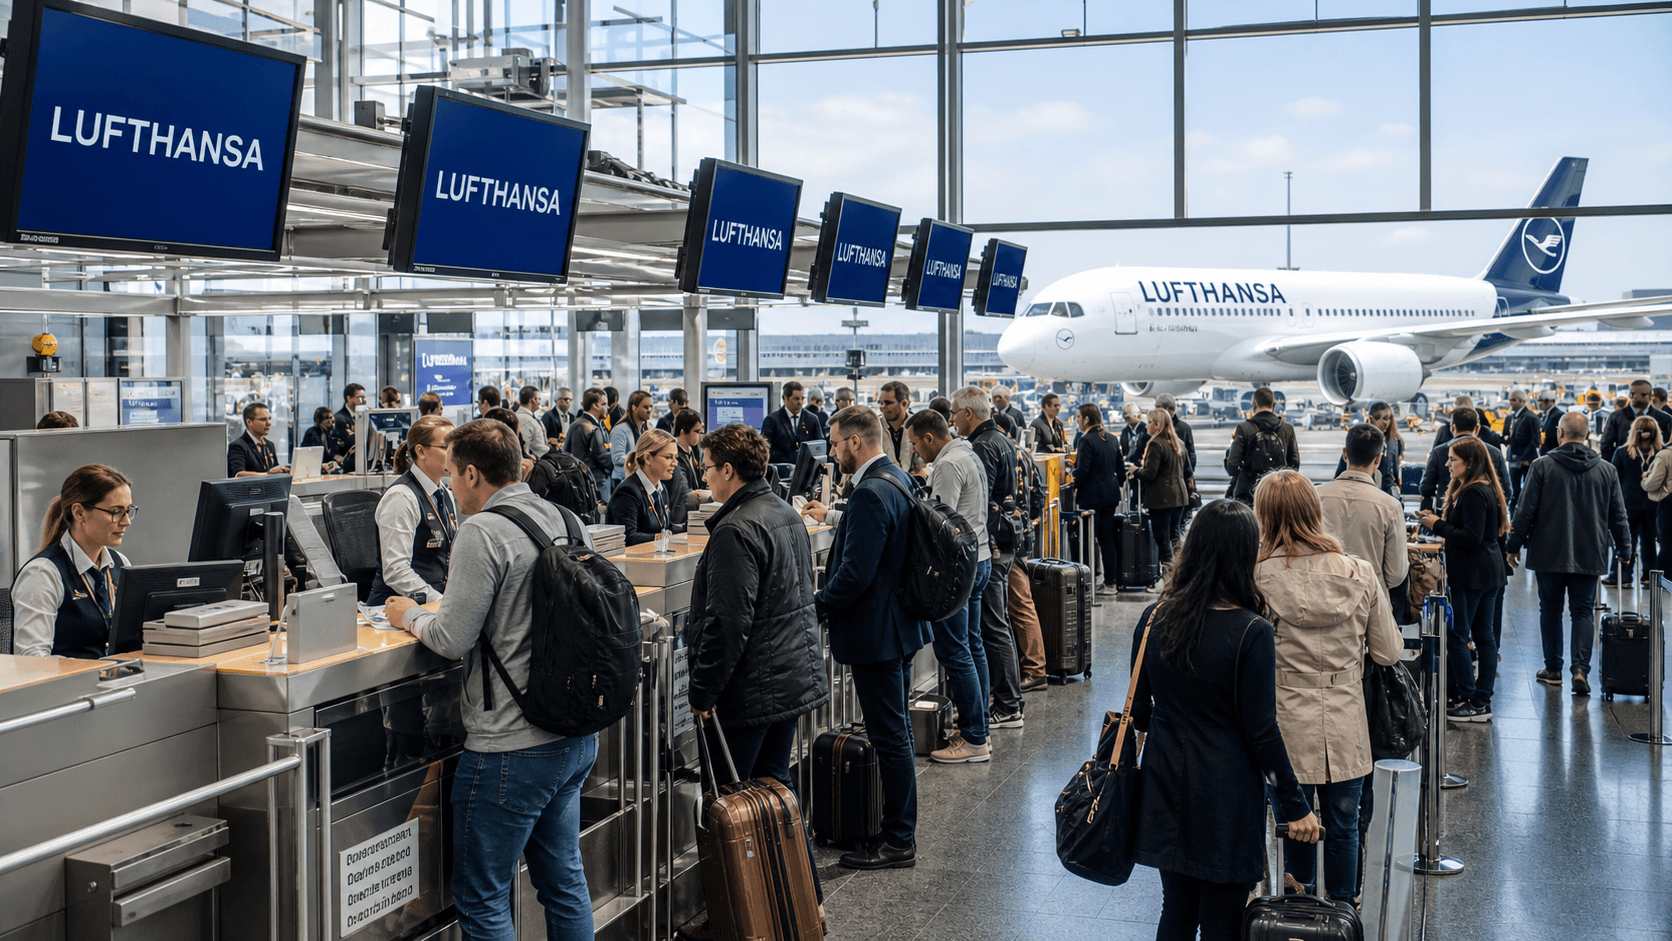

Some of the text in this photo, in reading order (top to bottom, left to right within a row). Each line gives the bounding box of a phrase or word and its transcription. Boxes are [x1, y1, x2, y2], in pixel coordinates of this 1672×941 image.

[50, 105, 264, 171] LUFTHANSA
[435, 170, 561, 216] LUFTHANSA
[711, 219, 783, 251] LUFTHANSA
[837, 242, 886, 268] LUFTHANSA
[926, 259, 962, 280] LUFTHANSA
[1139, 280, 1287, 304] LUFTHANSA
